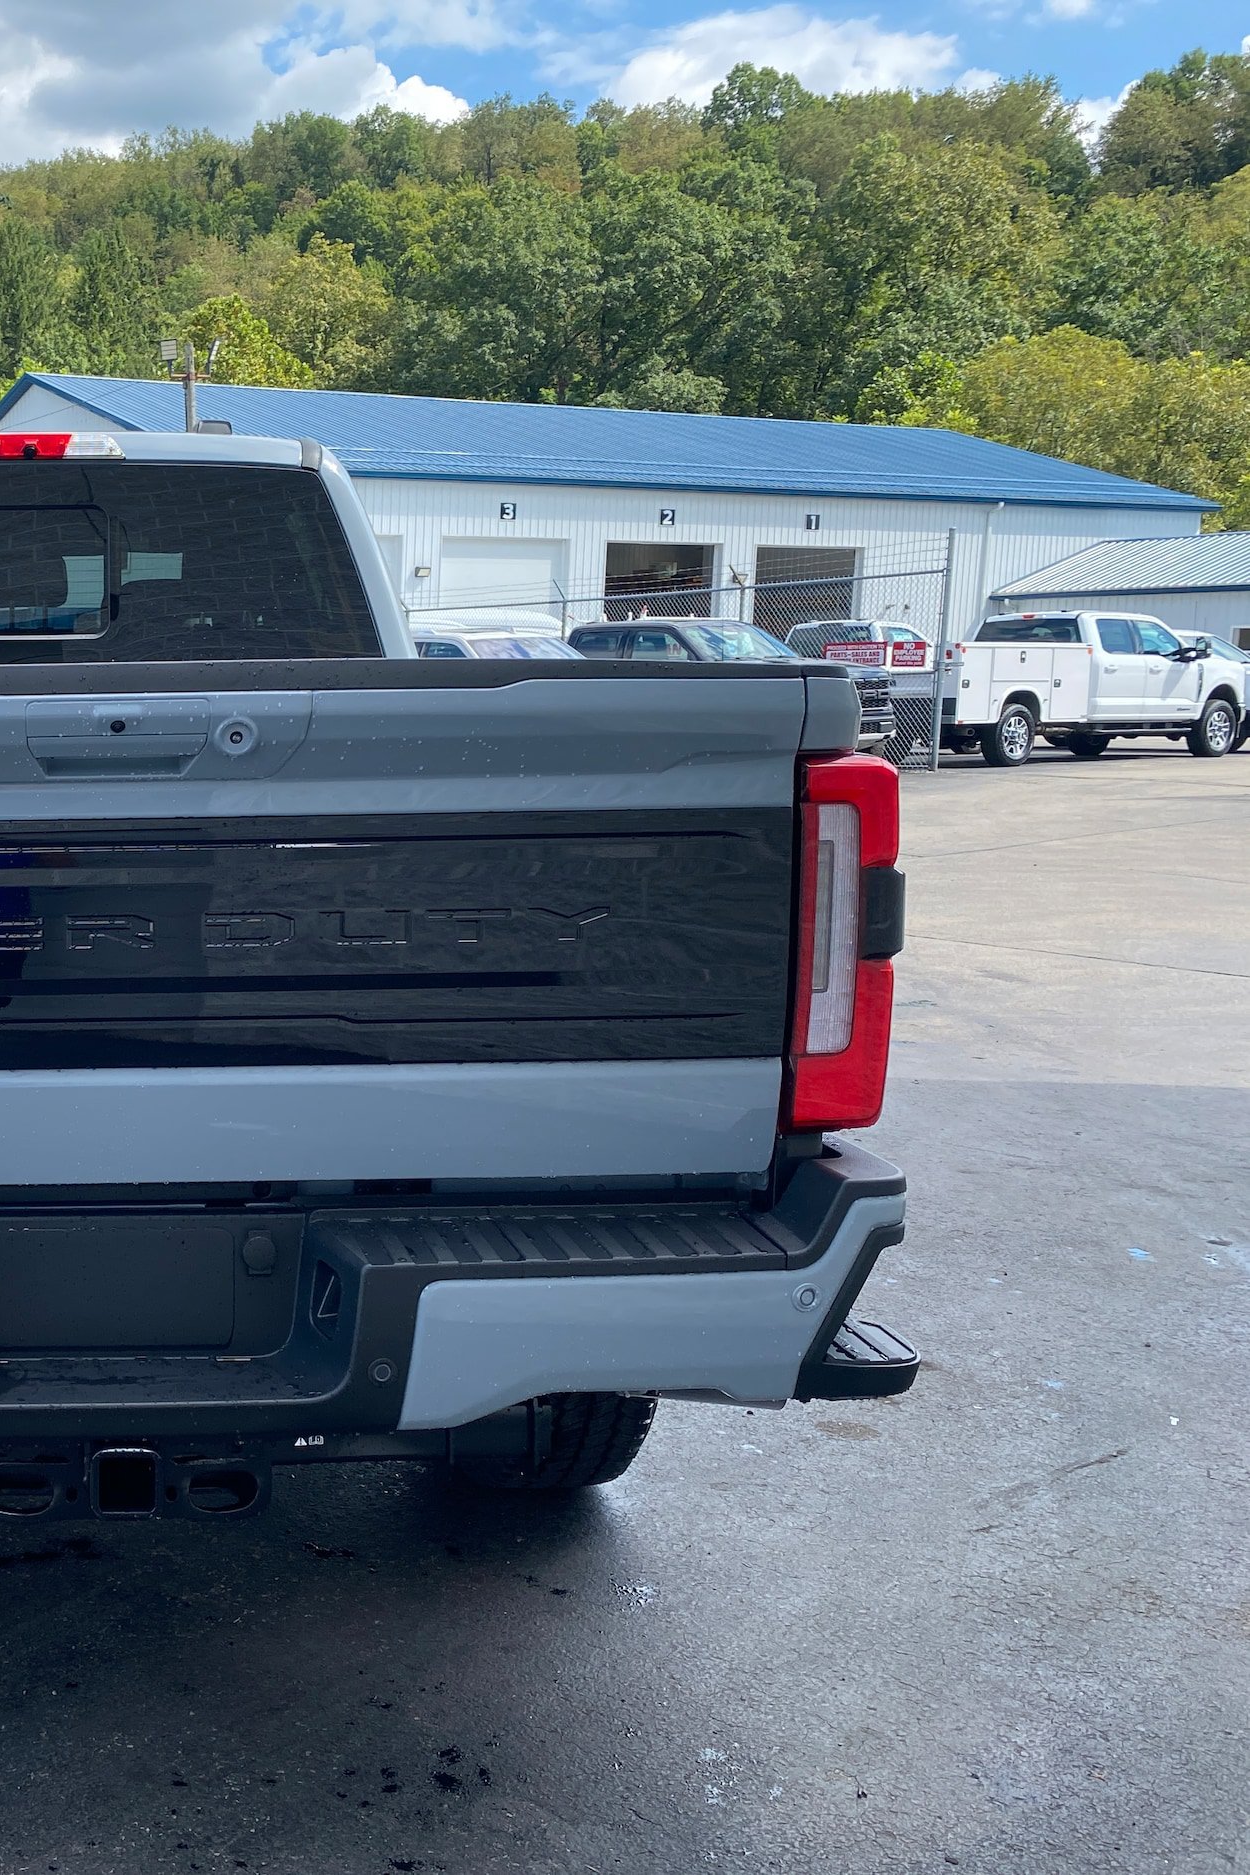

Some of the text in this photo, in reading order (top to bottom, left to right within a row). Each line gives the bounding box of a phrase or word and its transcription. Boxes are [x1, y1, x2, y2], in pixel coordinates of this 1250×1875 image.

[503, 504, 515, 519] 3
[662, 510, 673, 525] 2
[204, 906, 611, 948] DUTY
